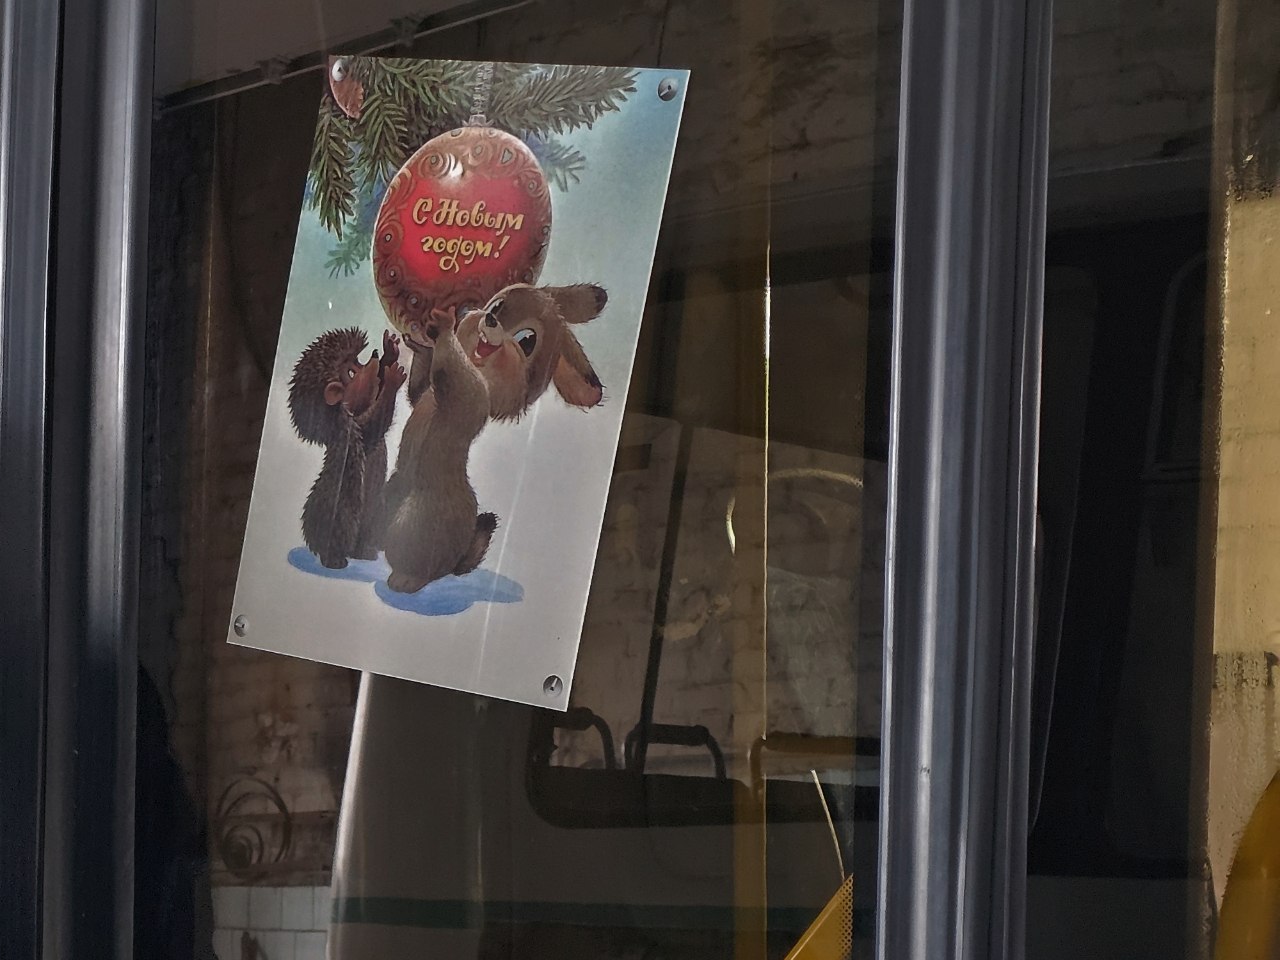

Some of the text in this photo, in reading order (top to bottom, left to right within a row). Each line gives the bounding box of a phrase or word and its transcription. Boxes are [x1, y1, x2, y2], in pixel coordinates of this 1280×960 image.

[412, 198, 525, 236] С Новым
[421, 235, 511, 274] годом!
